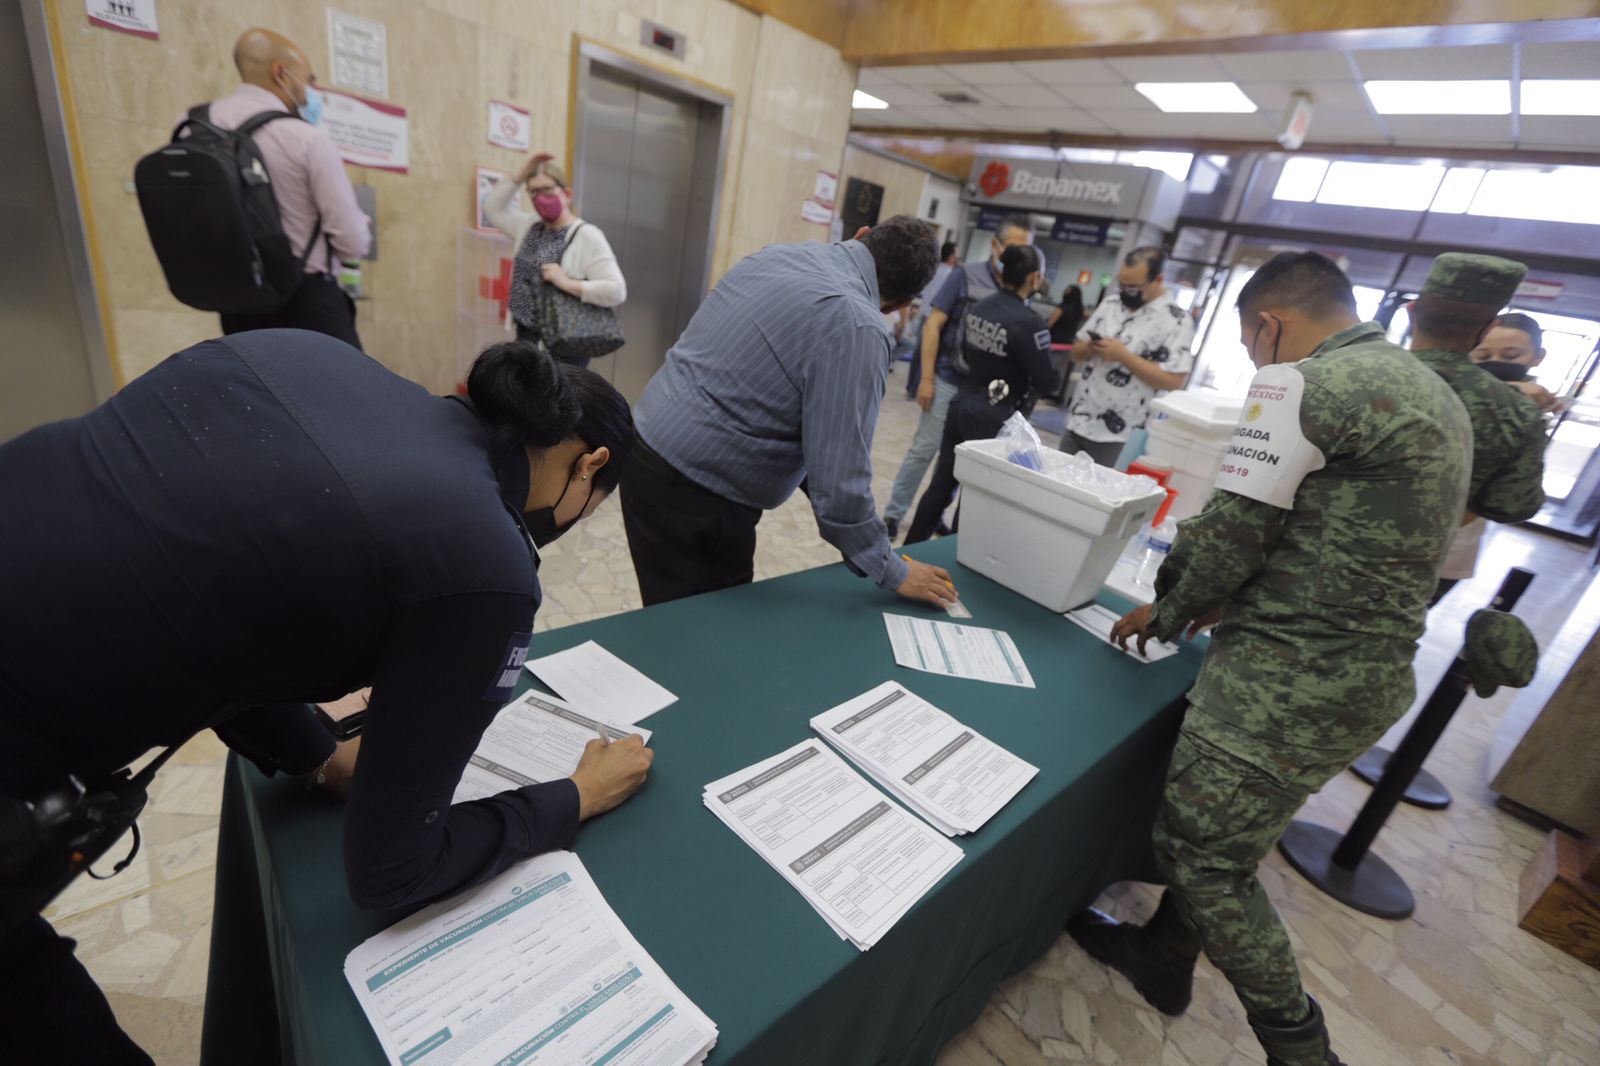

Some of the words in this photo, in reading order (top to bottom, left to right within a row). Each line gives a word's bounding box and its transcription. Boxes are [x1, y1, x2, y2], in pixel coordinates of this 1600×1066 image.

[1012, 169, 1124, 203] Banamex
[1234, 427, 1270, 442] IGADA
[383, 946, 429, 976] EXPEDIENTE
[428, 940, 439, 950] DE
[438, 916, 483, 944] VACUNACIÓN
[511, 1026, 555, 1060] VACUNACIÓN
[554, 1010, 580, 1030] CONTRA
